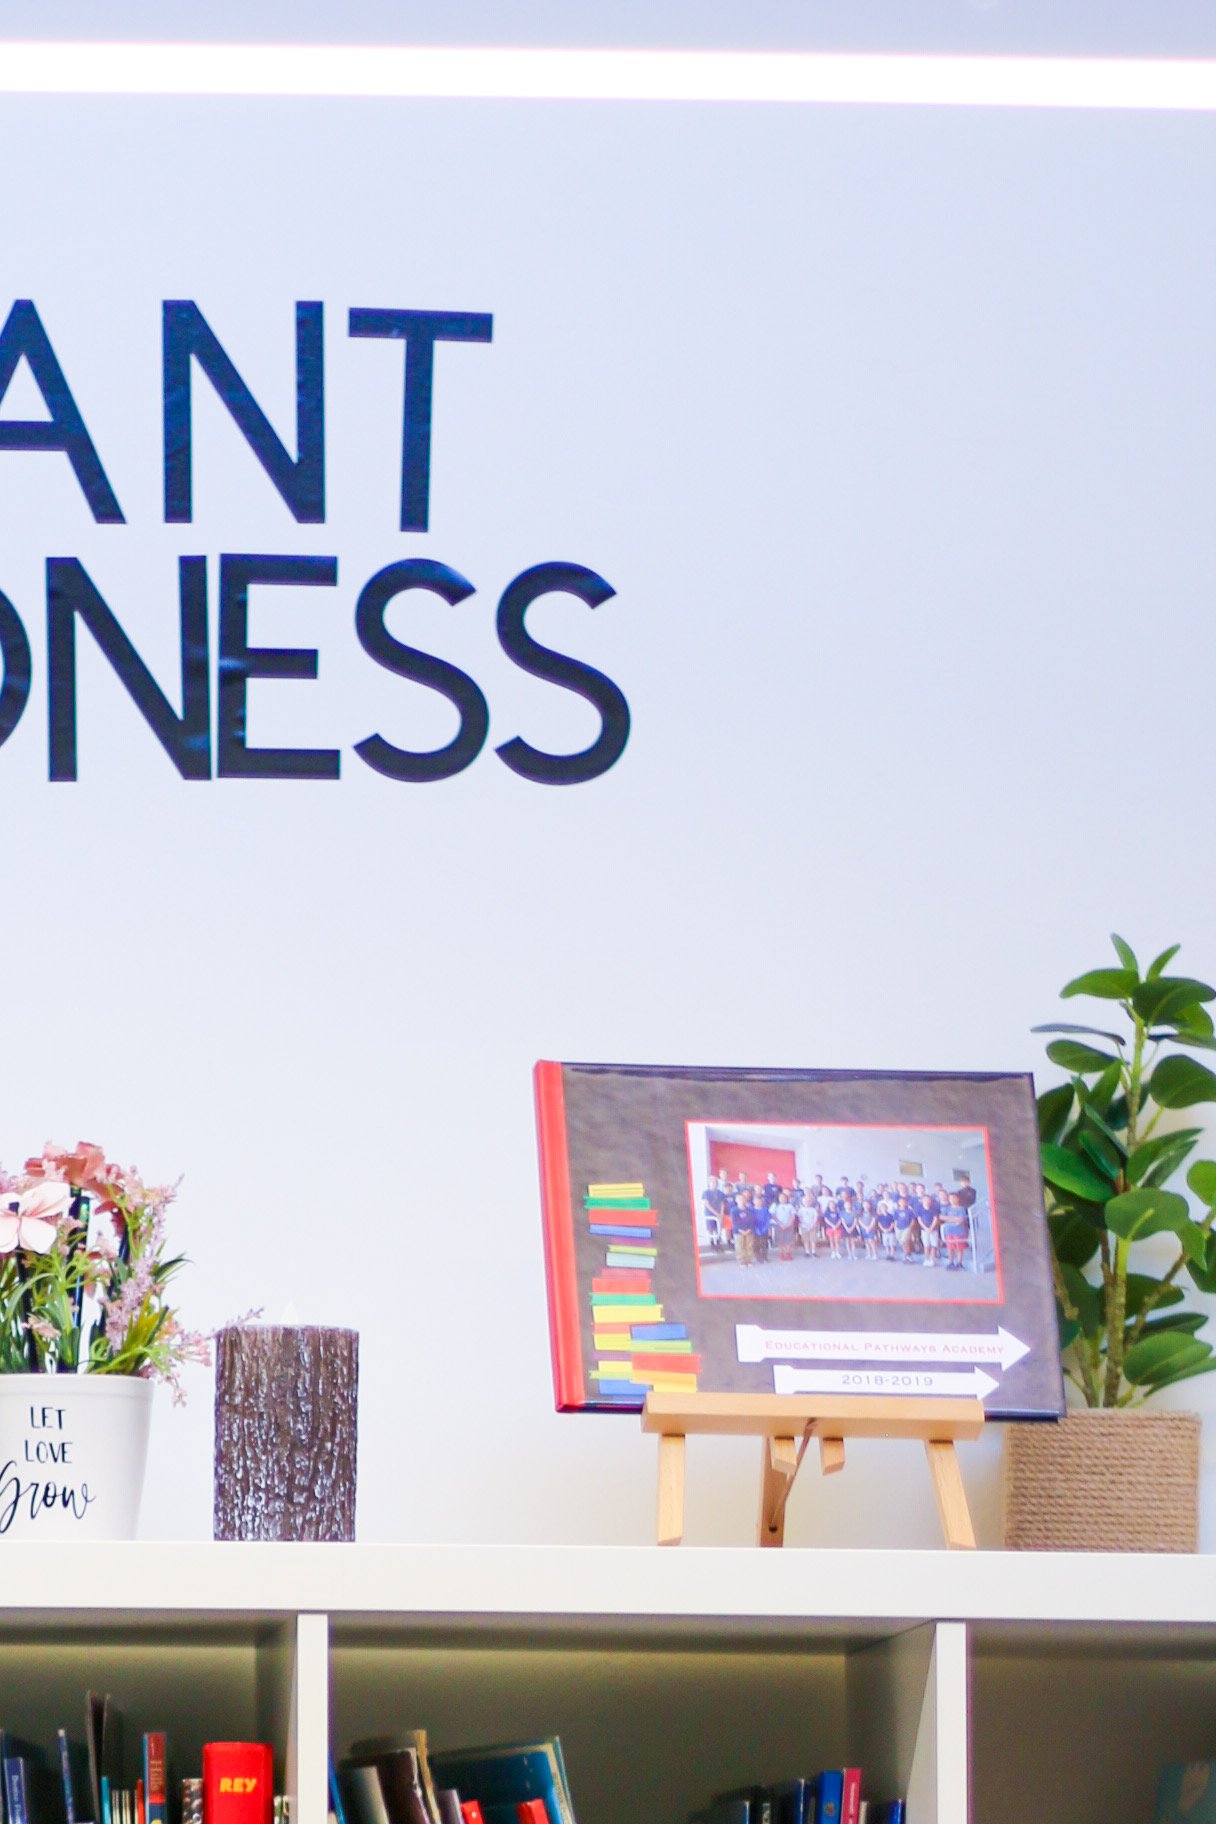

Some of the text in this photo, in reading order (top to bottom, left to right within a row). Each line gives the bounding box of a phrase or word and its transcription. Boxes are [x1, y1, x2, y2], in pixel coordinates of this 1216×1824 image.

[842, 1375, 933, 1387] 2018-2019
[30, 1406, 66, 1430] LET
[24, 1439, 73, 1464] LOVE
[219, 1777, 257, 1793] REY
